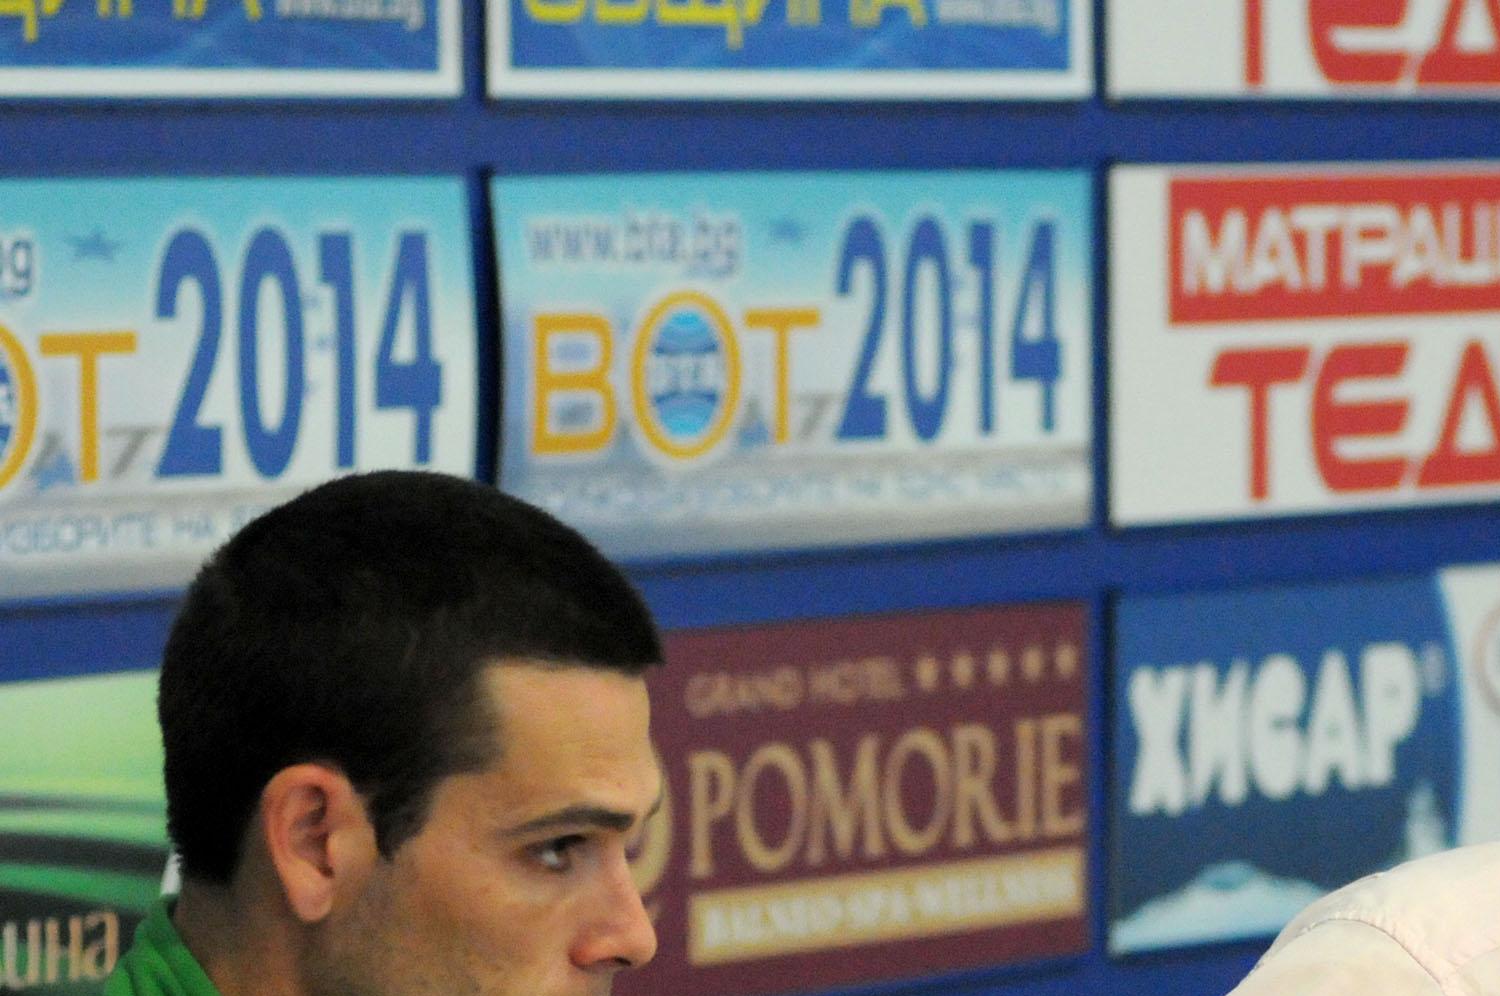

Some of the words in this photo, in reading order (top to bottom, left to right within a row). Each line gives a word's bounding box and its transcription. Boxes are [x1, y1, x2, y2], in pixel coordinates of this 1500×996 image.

[155, 226, 442, 479] 2014
[532, 291, 820, 460] ВОТ
[835, 213, 1061, 442] 2014
[1128, 643, 1421, 815] ХИСАР
